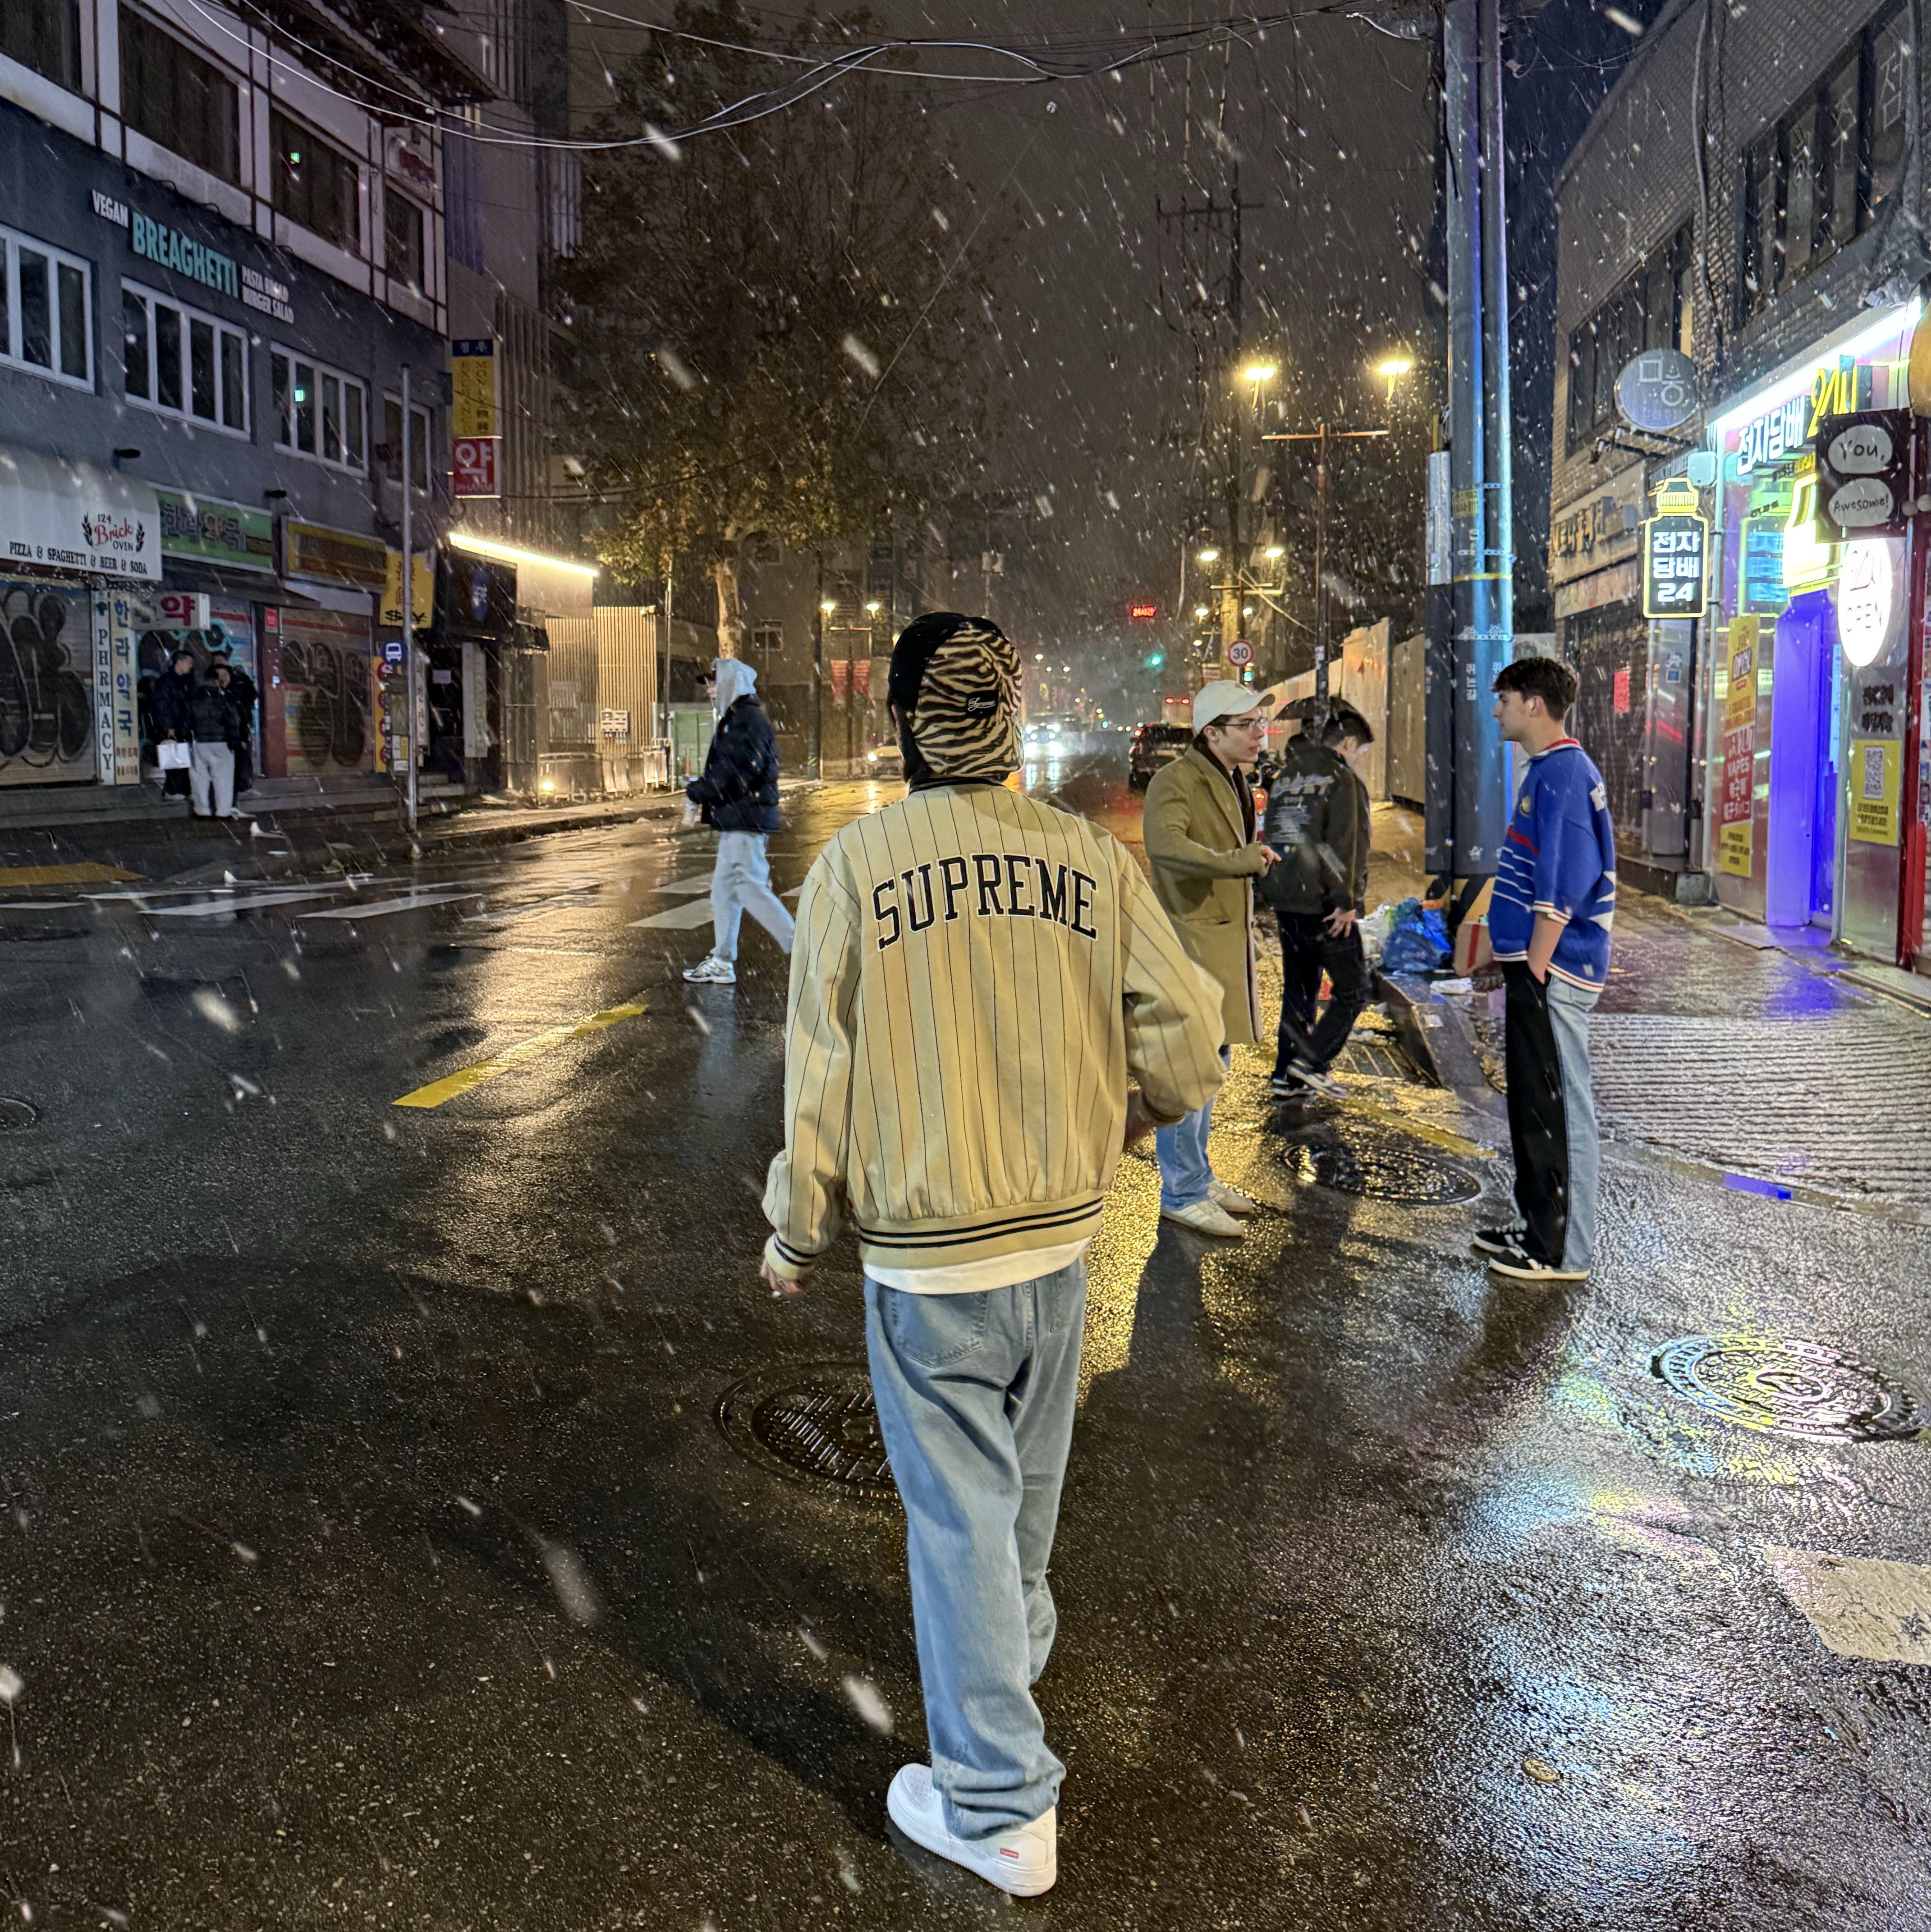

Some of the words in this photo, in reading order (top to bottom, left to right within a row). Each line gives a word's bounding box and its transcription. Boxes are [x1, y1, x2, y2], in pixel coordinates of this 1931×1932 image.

[92, 189, 128, 228] VEGAN
[133, 211, 239, 298] BREAGHETTI
[1737, 395, 1805, 476] 전자담배
[455, 442, 492, 484] 약
[1833, 494, 1889, 514] Awesome!
[94, 517, 133, 545] Brick
[98, 514, 112, 523] 124
[113, 541, 133, 551] OVEN
[1653, 531, 1701, 553] 전자
[9, 541, 32, 558] PIZZA
[37, 546, 43, 559] &
[47, 547, 86, 566] SPAGHETTI
[100, 556, 117, 570] BEER
[130, 561, 147, 574] SODA
[1653, 557, 1700, 578] 담배
[1658, 582, 1693, 602] 24
[161, 595, 196, 626] 약
[1233, 647, 1248, 659] 30
[98, 629, 113, 770] PHRMACY
[871, 853, 1098, 951] SUPREME
